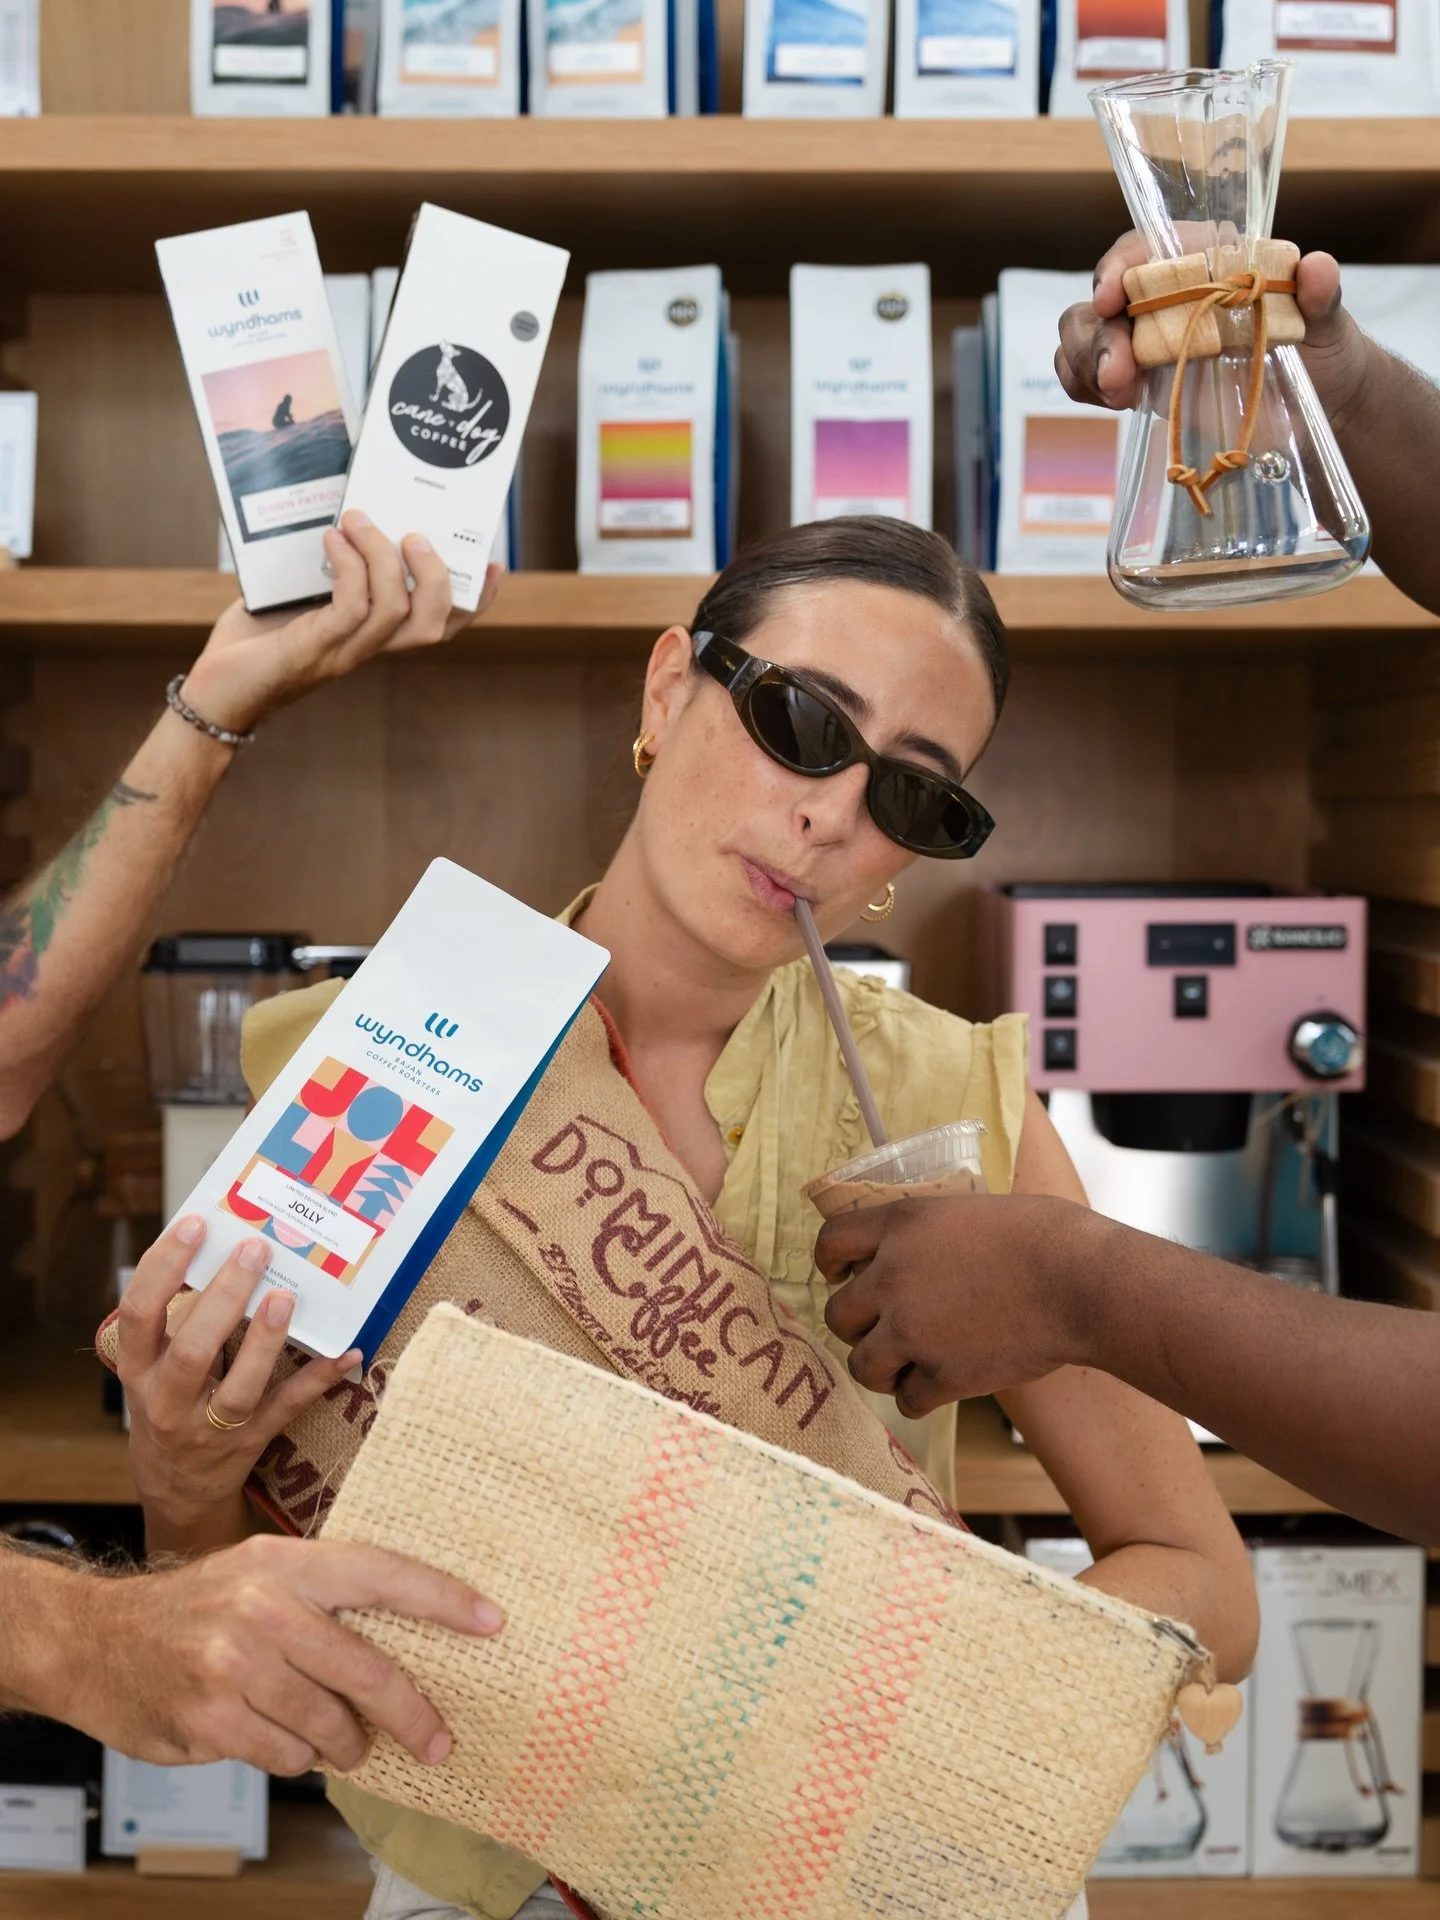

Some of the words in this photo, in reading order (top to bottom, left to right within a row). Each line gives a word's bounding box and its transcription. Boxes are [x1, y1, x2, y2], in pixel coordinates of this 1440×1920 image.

[207, 307, 303, 339] wyndhams
[410, 424, 468, 452] COFFEE
[455, 399, 502, 466] dog
[355, 1013, 484, 1093] wyndhams
[394, 1057, 423, 1077] BAJAN
[366, 1050, 398, 1071] COFFEE
[398, 1069, 441, 1096] ROASTERS
[286, 1184, 304, 1198] LIMITED
[304, 1194, 322, 1210] EDITION
[288, 1200, 324, 1225] JOLLY
[269, 1267, 299, 1288] BARBADOS
[530, 1122, 832, 1430] DOMINICAN
[592, 1223, 718, 1378] Coffee
